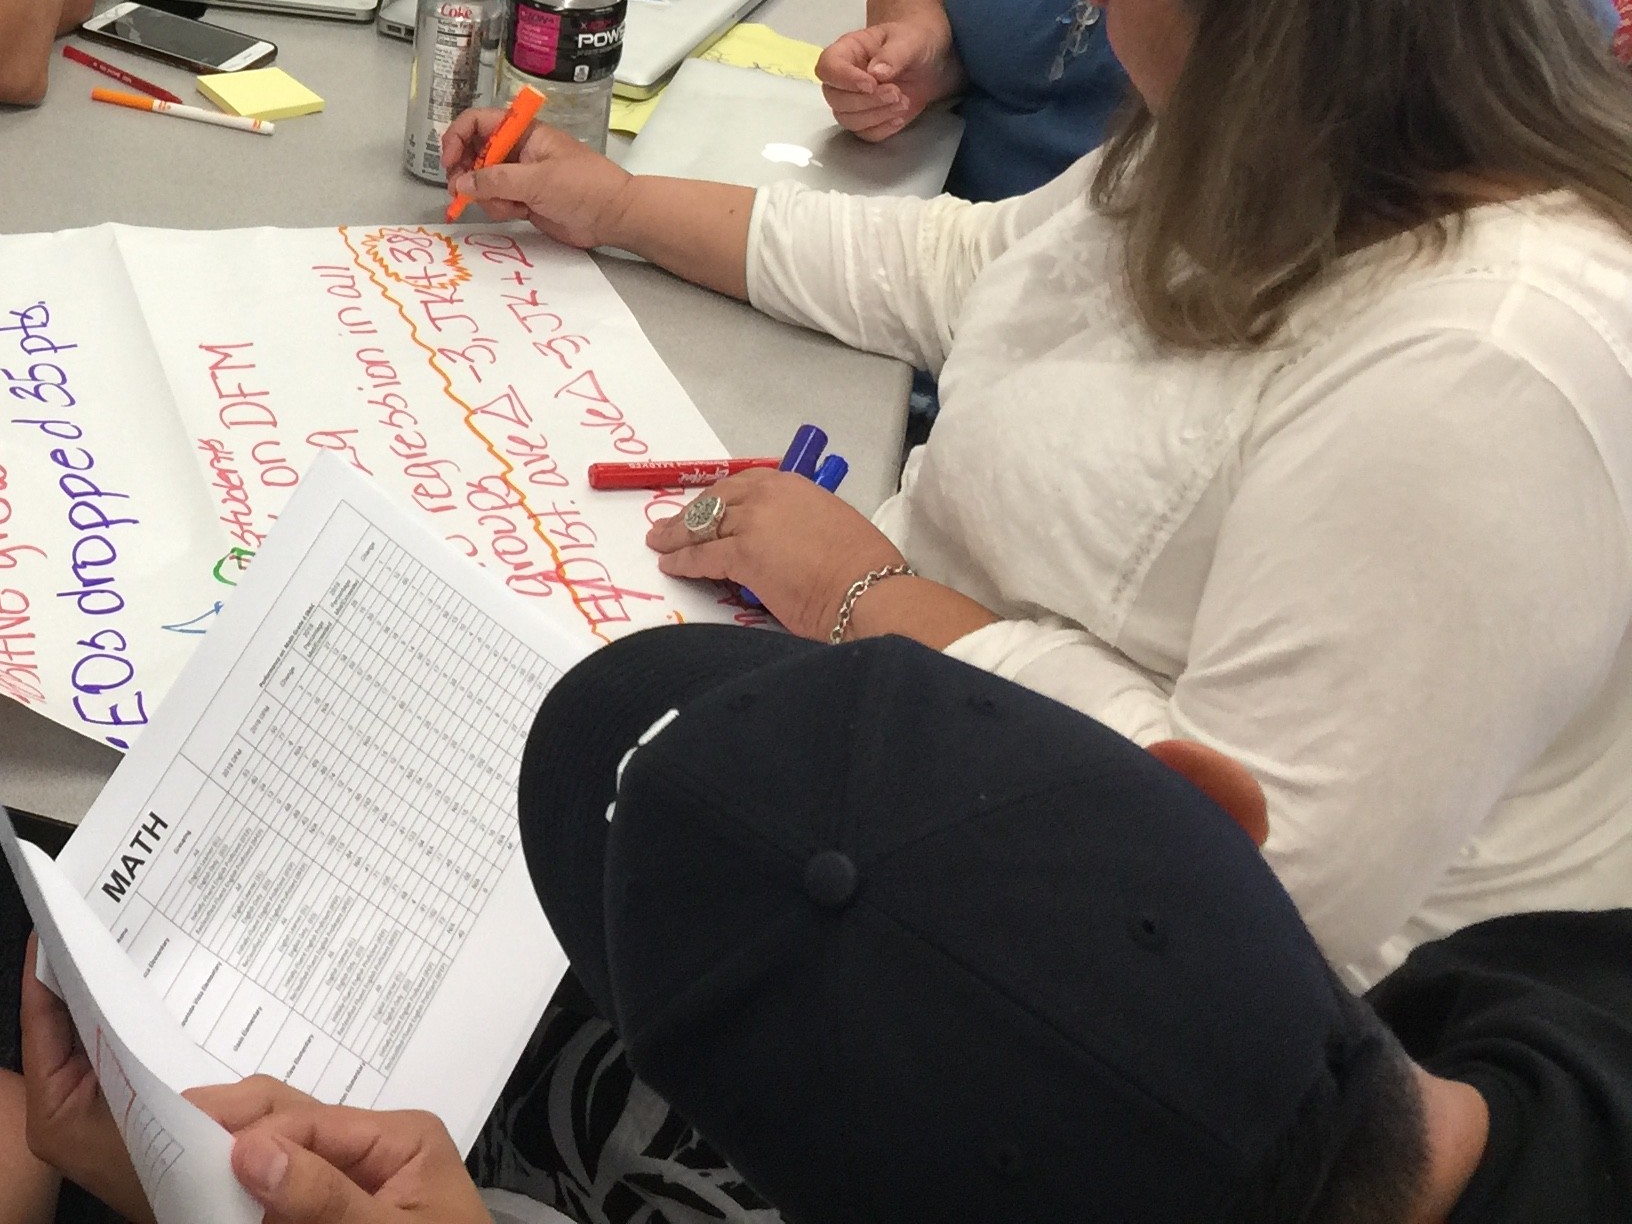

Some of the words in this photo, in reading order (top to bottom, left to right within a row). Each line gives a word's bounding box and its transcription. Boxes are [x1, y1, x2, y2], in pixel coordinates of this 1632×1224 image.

[440, 2, 473, 18] Coke
[312, 265, 363, 301] all
[338, 306, 377, 336] in
[199, 342, 278, 428] DFM
[356, 348, 462, 512] regression
[250, 440, 299, 487] on
[11, 418, 139, 615] dropped
[101, 811, 169, 904] MATH
